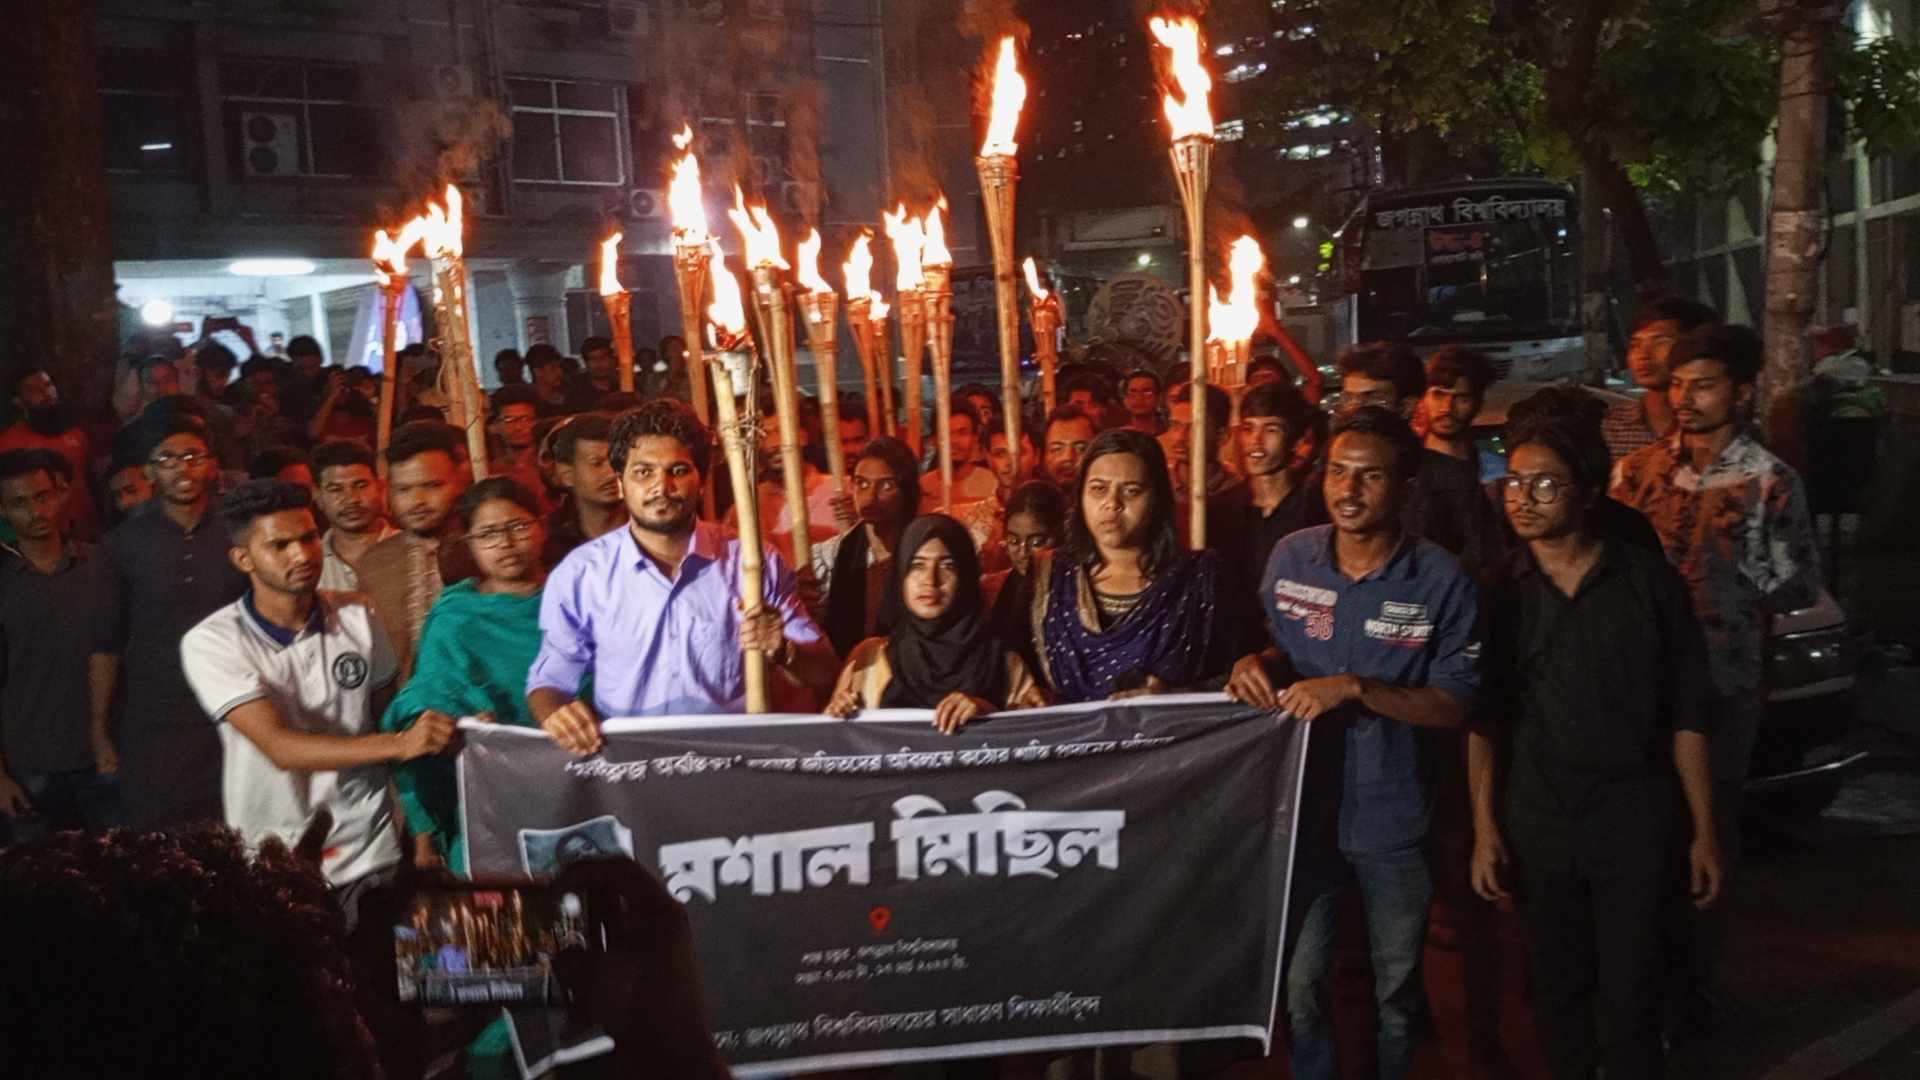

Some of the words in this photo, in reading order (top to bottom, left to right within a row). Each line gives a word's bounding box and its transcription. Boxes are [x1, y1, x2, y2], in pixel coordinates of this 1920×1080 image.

[1376, 204, 1445, 229] জগন্নাথ
[1453, 195, 1566, 222] বিশ্ববিদ্যালয়
[658, 821, 875, 903] মশাল
[890, 790, 1126, 879] মিছিল
